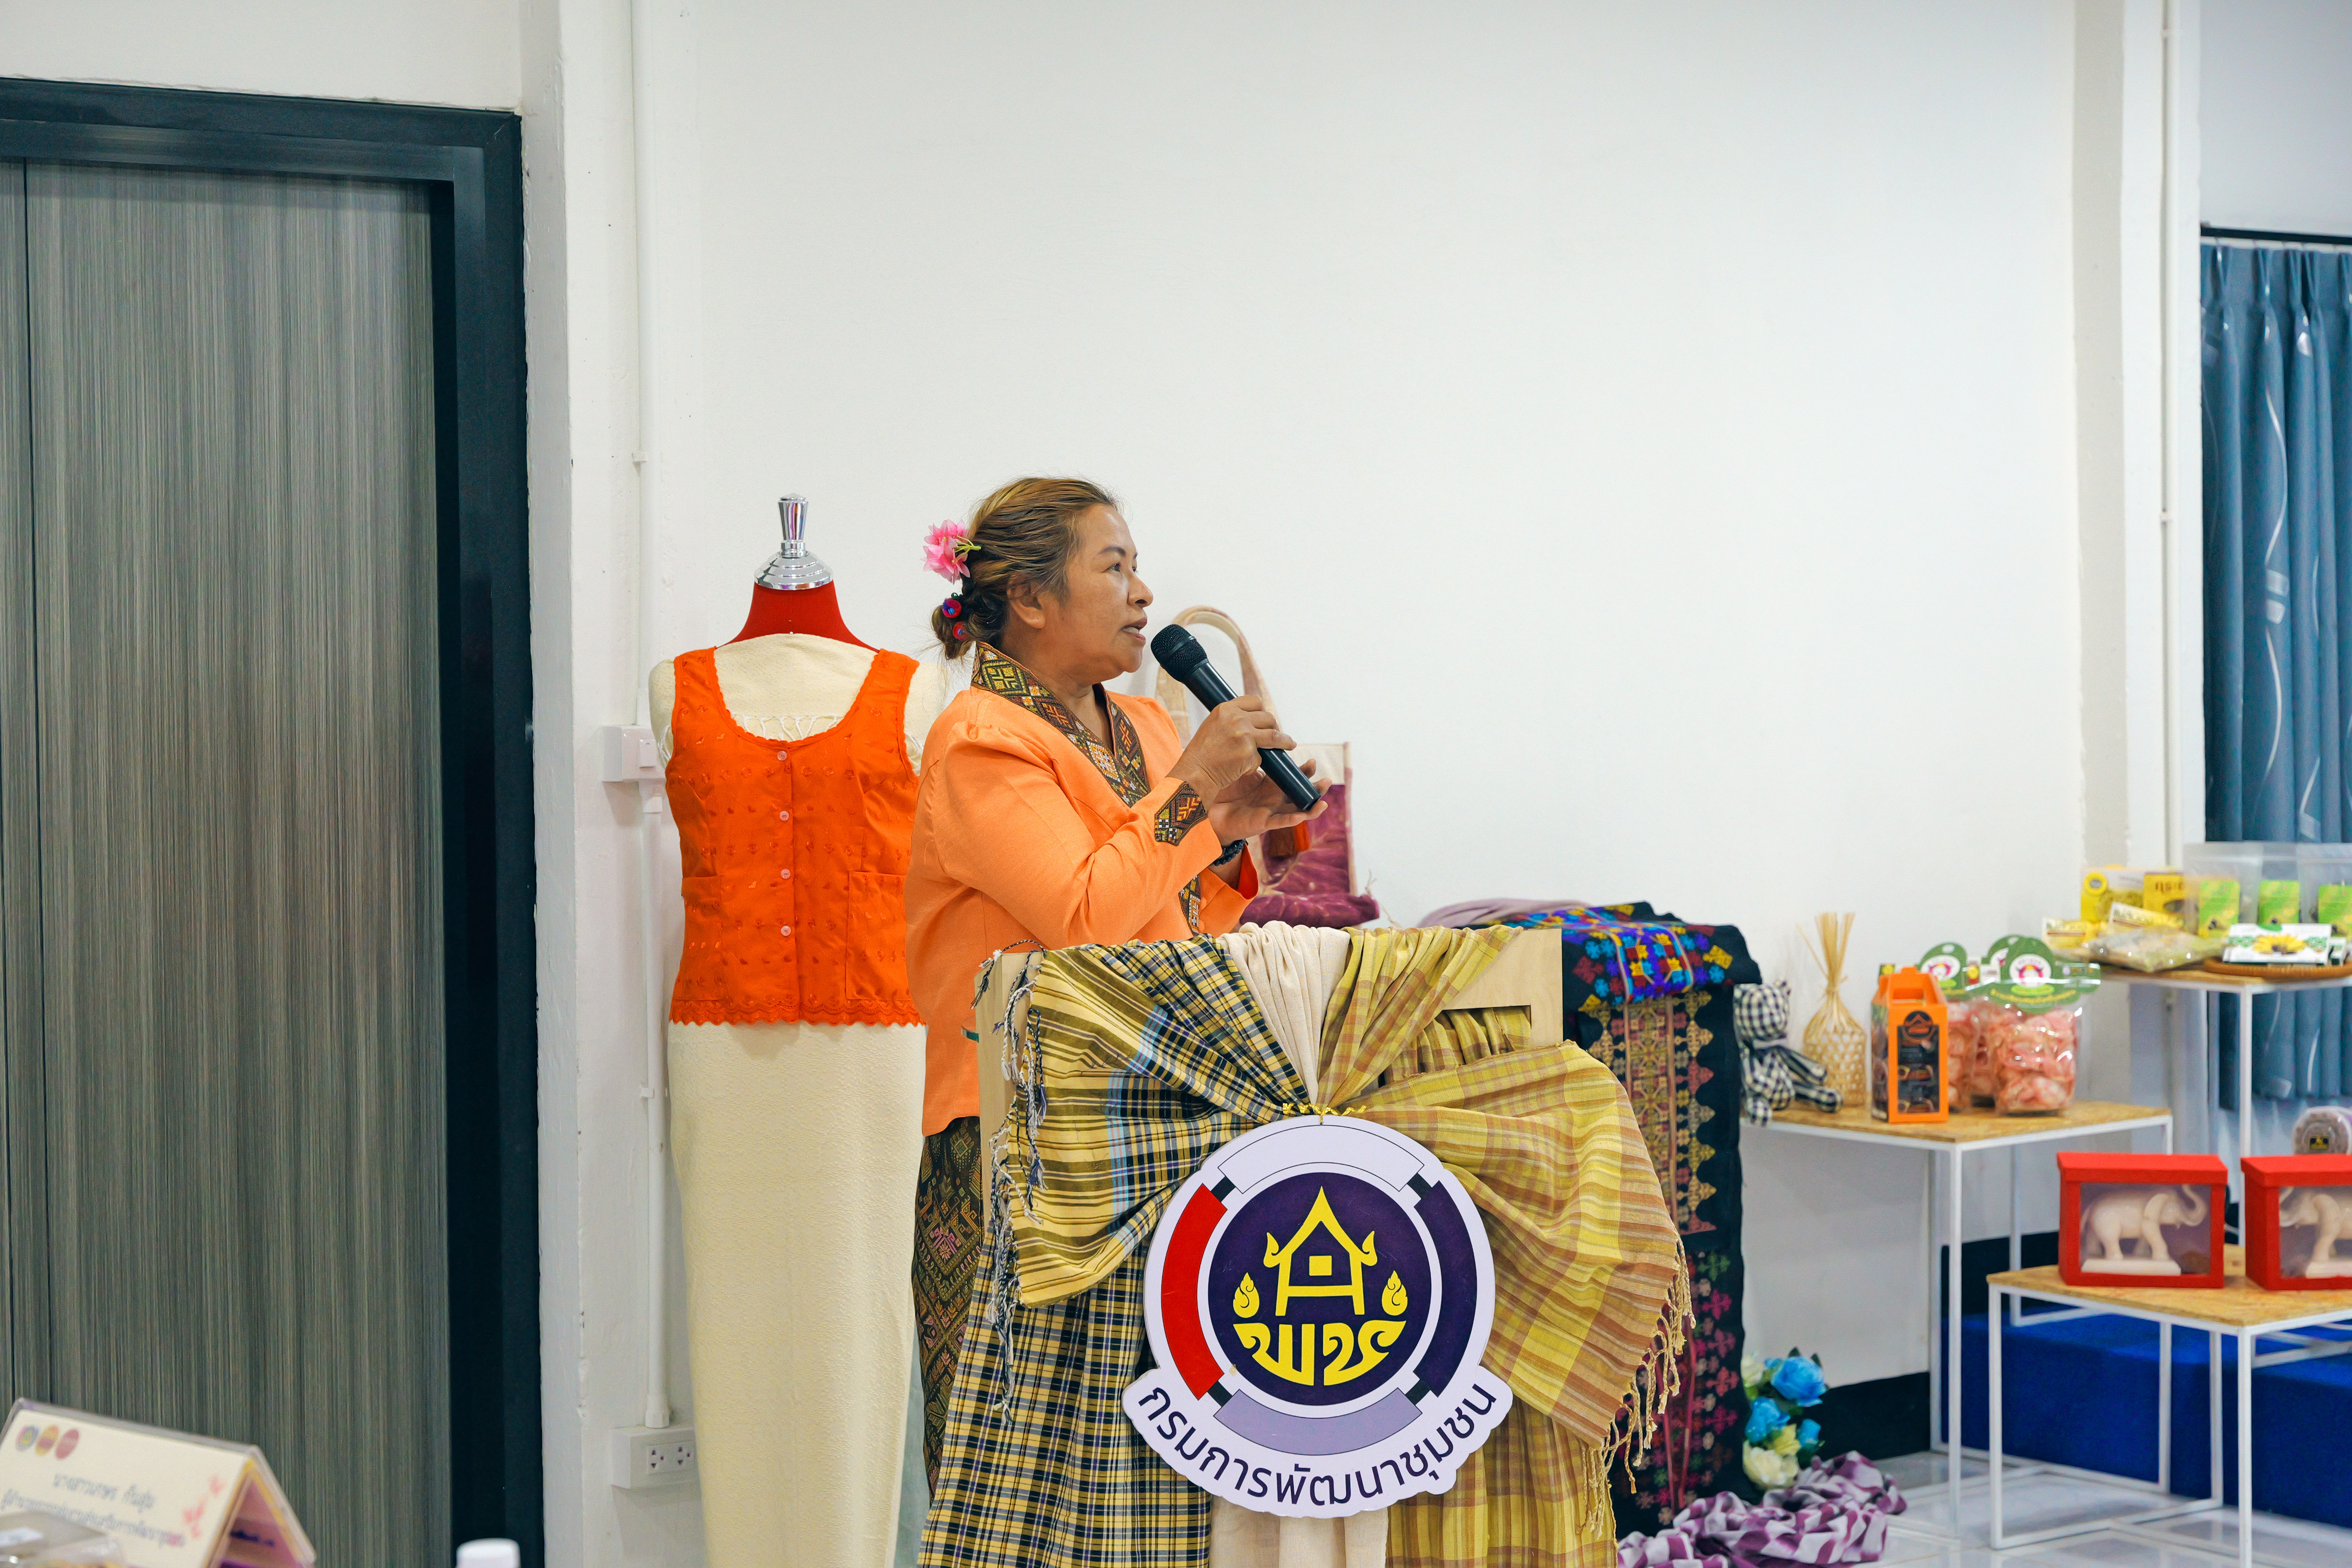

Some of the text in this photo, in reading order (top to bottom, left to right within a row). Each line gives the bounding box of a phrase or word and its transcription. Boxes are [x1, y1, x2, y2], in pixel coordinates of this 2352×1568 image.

[1138, 1383, 1497, 1506] กรมการพัฒนาชุมชน
